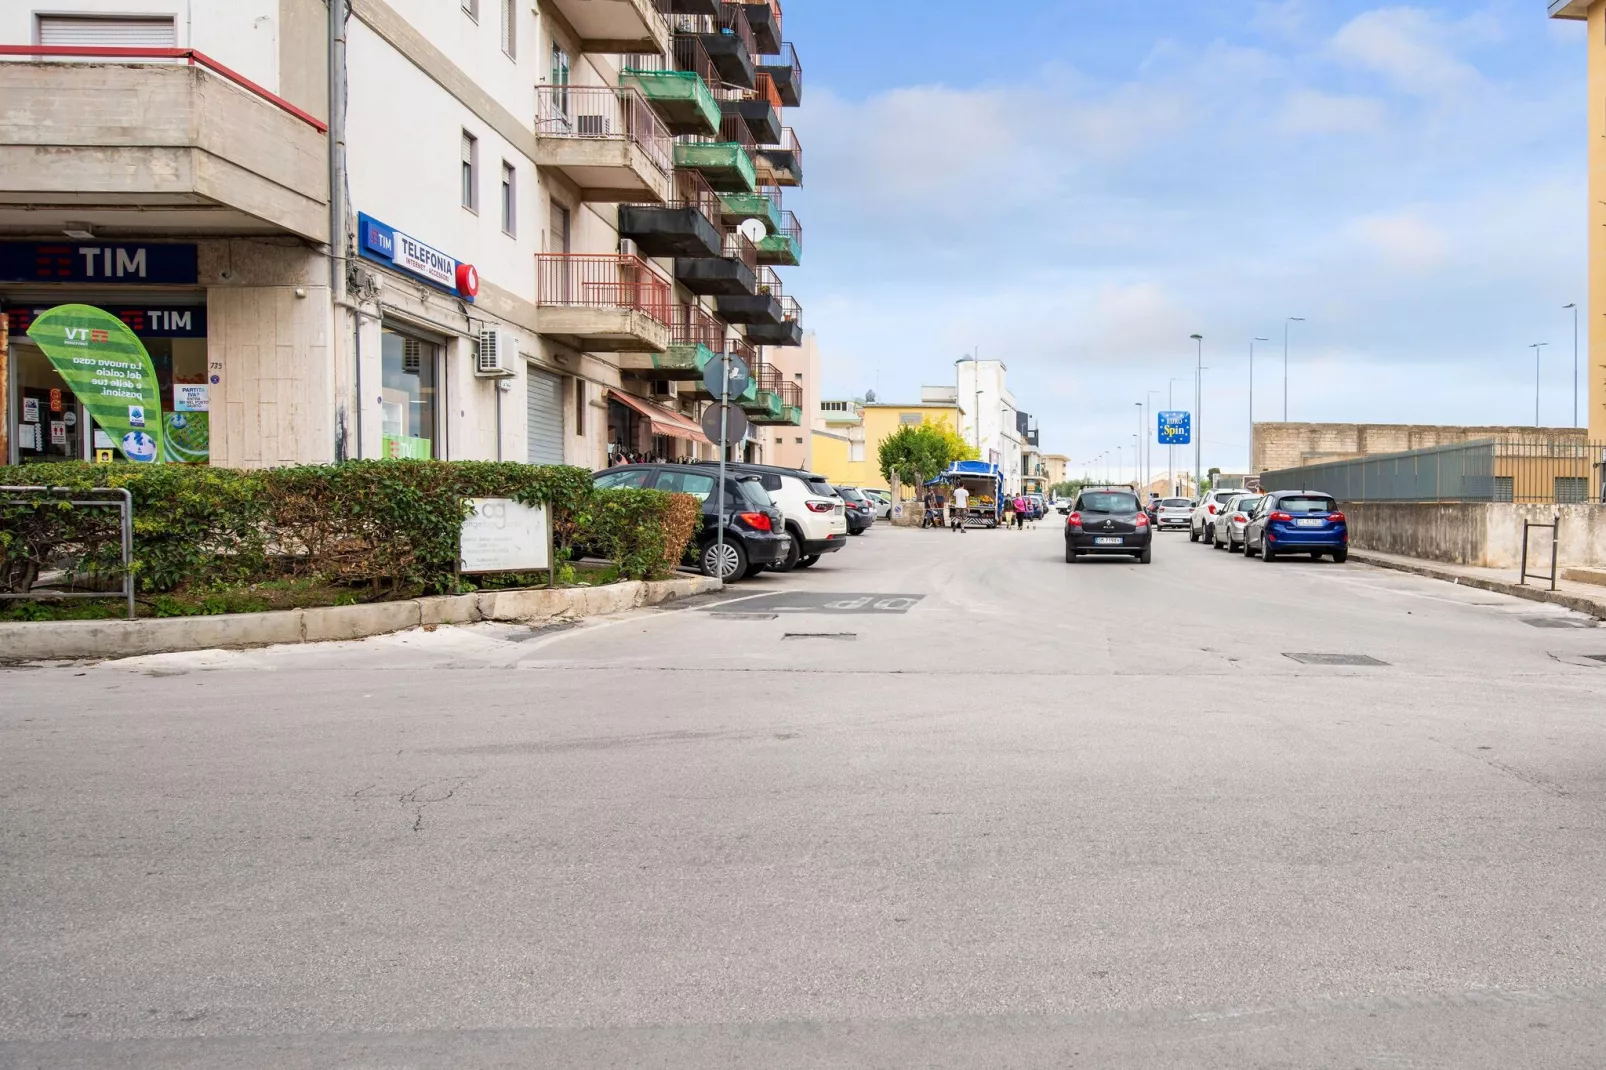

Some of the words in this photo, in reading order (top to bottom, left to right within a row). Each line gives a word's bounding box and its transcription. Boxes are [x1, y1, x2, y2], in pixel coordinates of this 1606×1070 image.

[378, 233, 392, 251] TIM
[79, 247, 147, 278] TIM
[401, 238, 453, 276] TELEFONIA
[405, 257, 426, 271] INTERNET
[147, 310, 192, 331] TIM
[1164, 424, 1185, 437] Spin
